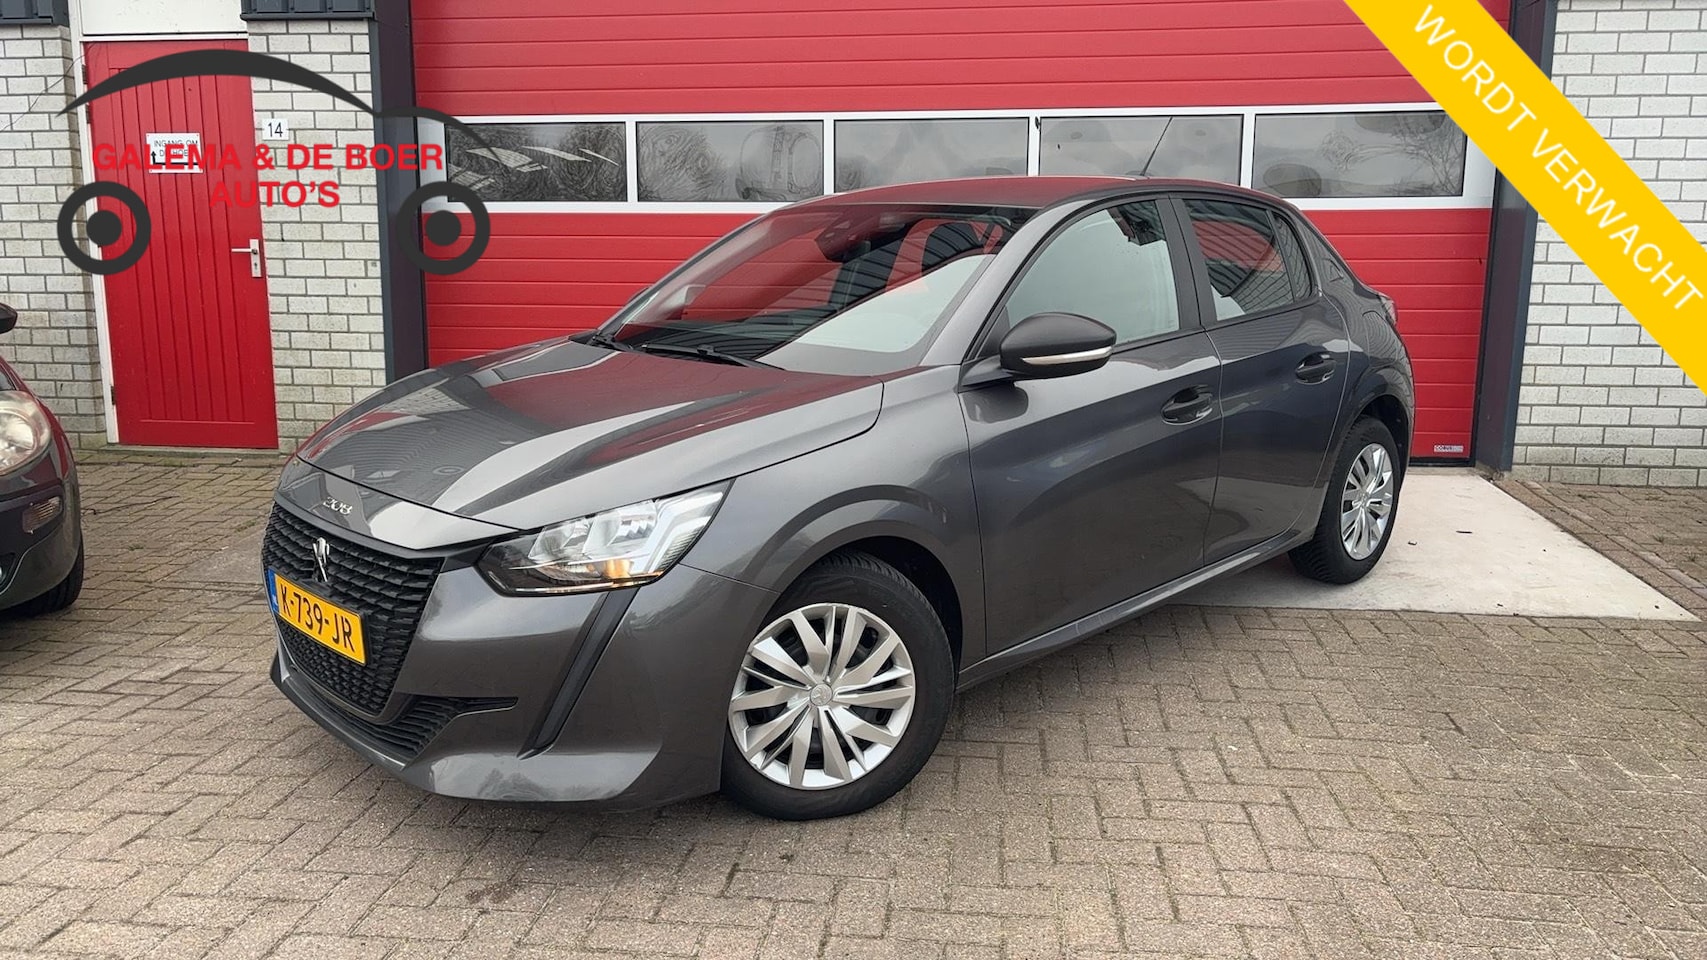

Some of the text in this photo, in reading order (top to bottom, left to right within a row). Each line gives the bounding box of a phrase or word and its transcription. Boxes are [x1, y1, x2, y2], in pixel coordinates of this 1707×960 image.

[267, 122, 283, 137] 14
[322, 496, 353, 515] 208
[281, 584, 356, 653] K-739-JR
